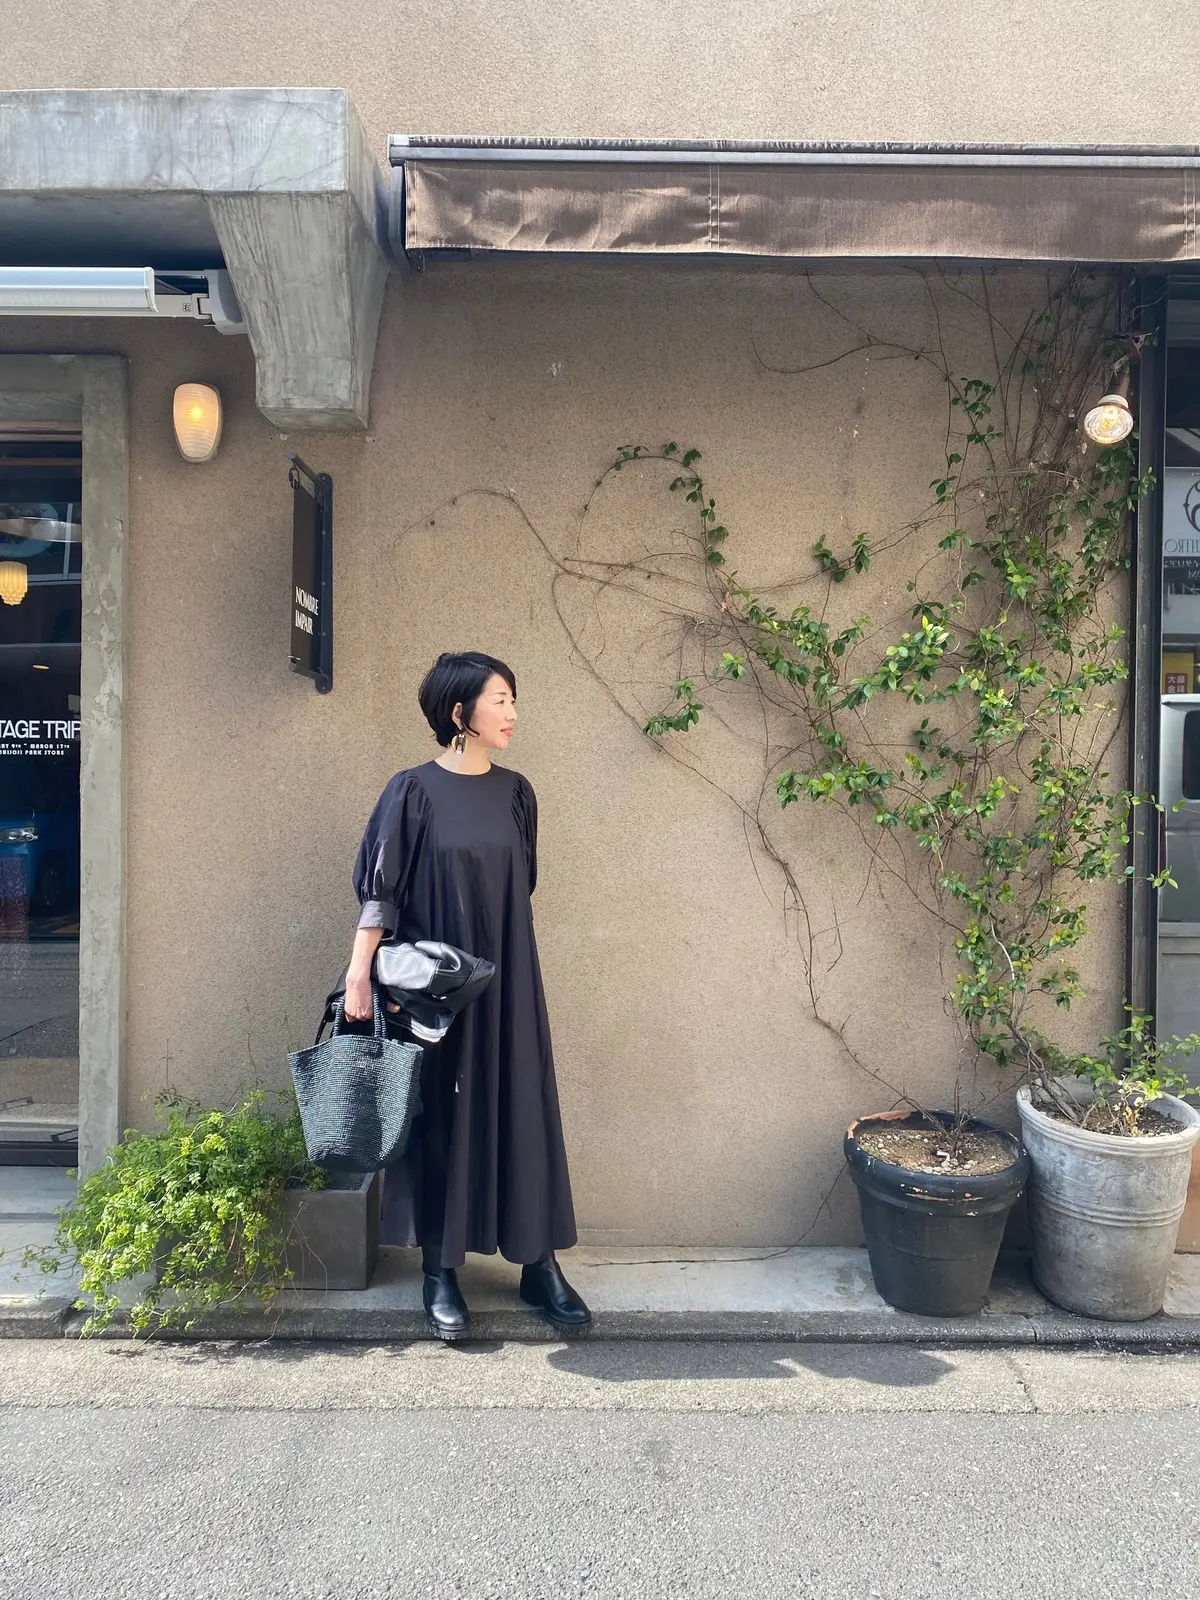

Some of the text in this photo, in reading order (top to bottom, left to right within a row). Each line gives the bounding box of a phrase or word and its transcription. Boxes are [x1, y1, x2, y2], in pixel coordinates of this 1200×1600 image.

[295, 586, 319, 616] NOMBRE
[295, 609, 314, 635] IMPAIR
[42, 720, 81, 739] TRIP
